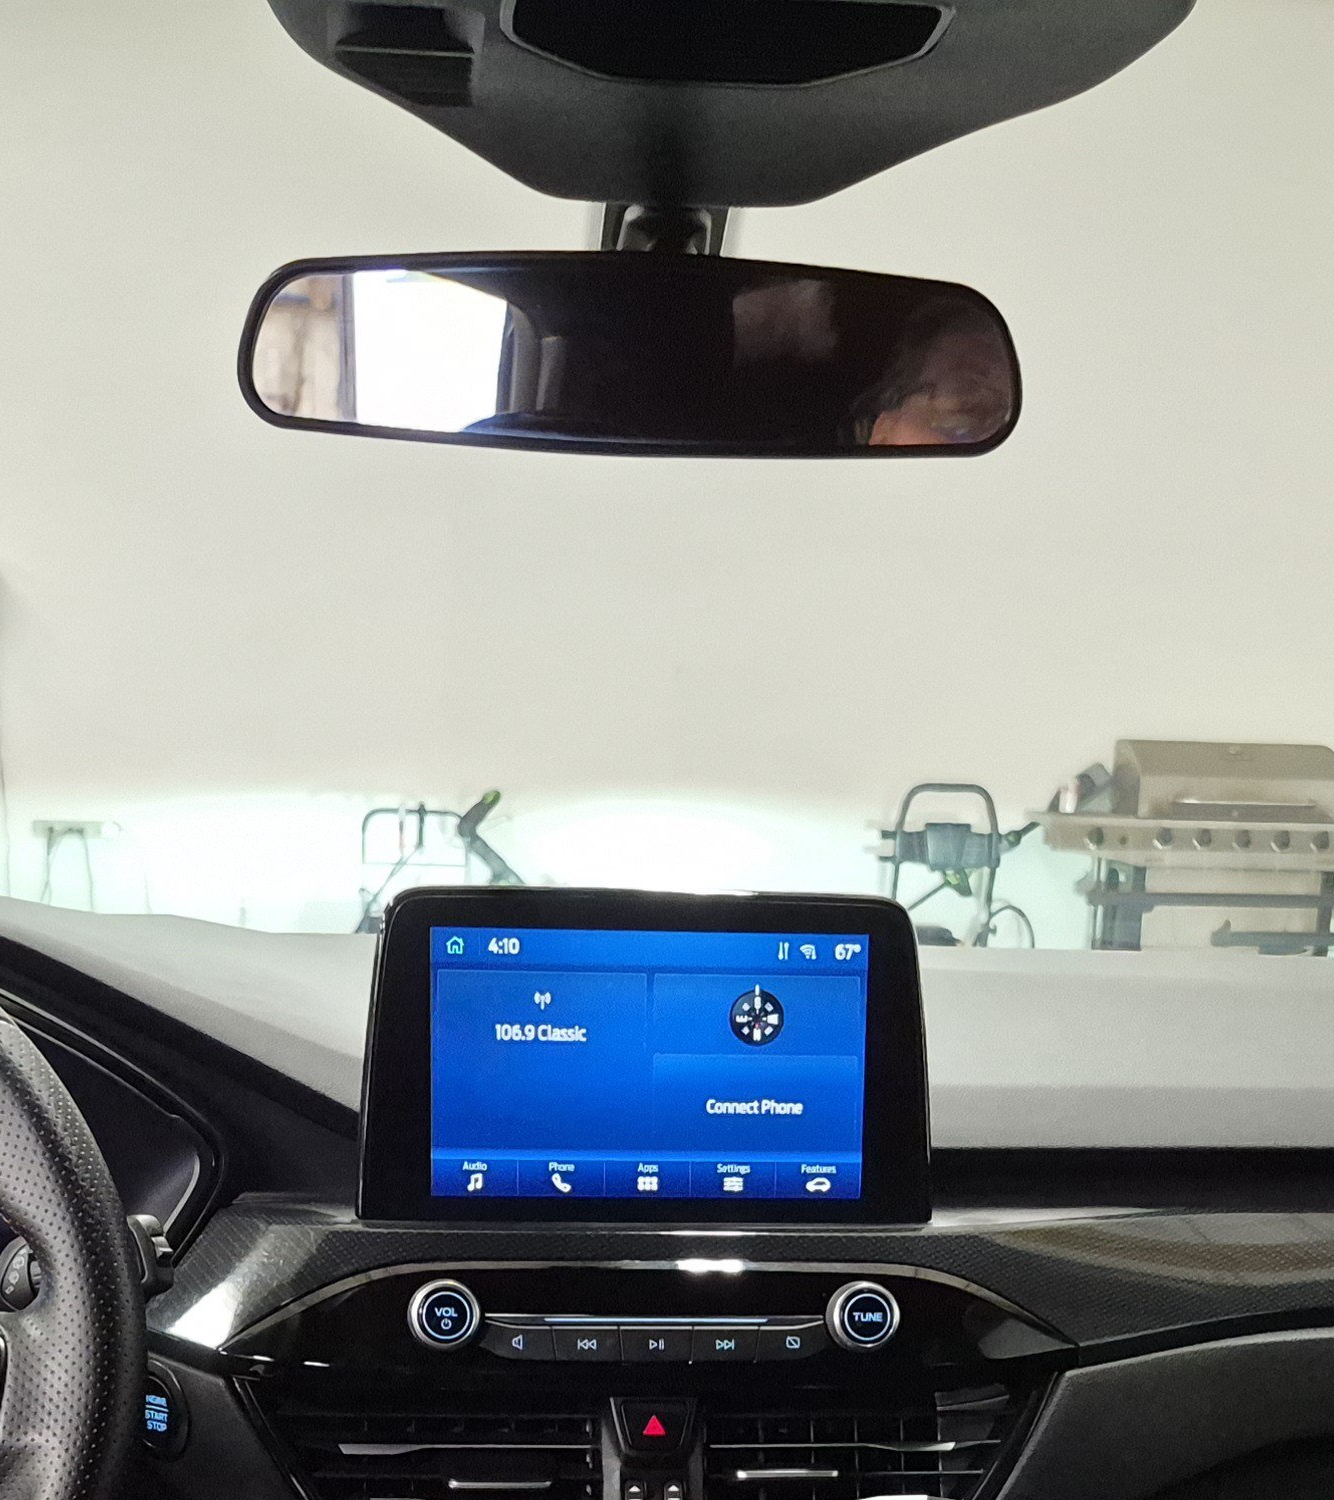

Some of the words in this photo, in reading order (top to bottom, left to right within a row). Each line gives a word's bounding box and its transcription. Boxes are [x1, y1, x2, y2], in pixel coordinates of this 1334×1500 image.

[487, 936, 520, 956] 4:10
[834, 942, 862, 962] 67°
[494, 1023, 534, 1043] 106.9
[537, 1023, 587, 1043] Classic
[705, 1098, 759, 1116] Connect
[761, 1098, 804, 1116] Phone
[462, 1161, 488, 1173] Audio
[548, 1161, 575, 1173] Phone
[637, 1162, 660, 1175] Apps
[716, 1163, 751, 1176] Settings
[800, 1164, 837, 1175] Features
[434, 1306, 458, 1318] VOL
[853, 1310, 883, 1324] TUNE
[144, 1410, 169, 1423] START
[147, 1421, 168, 1432] STOP
